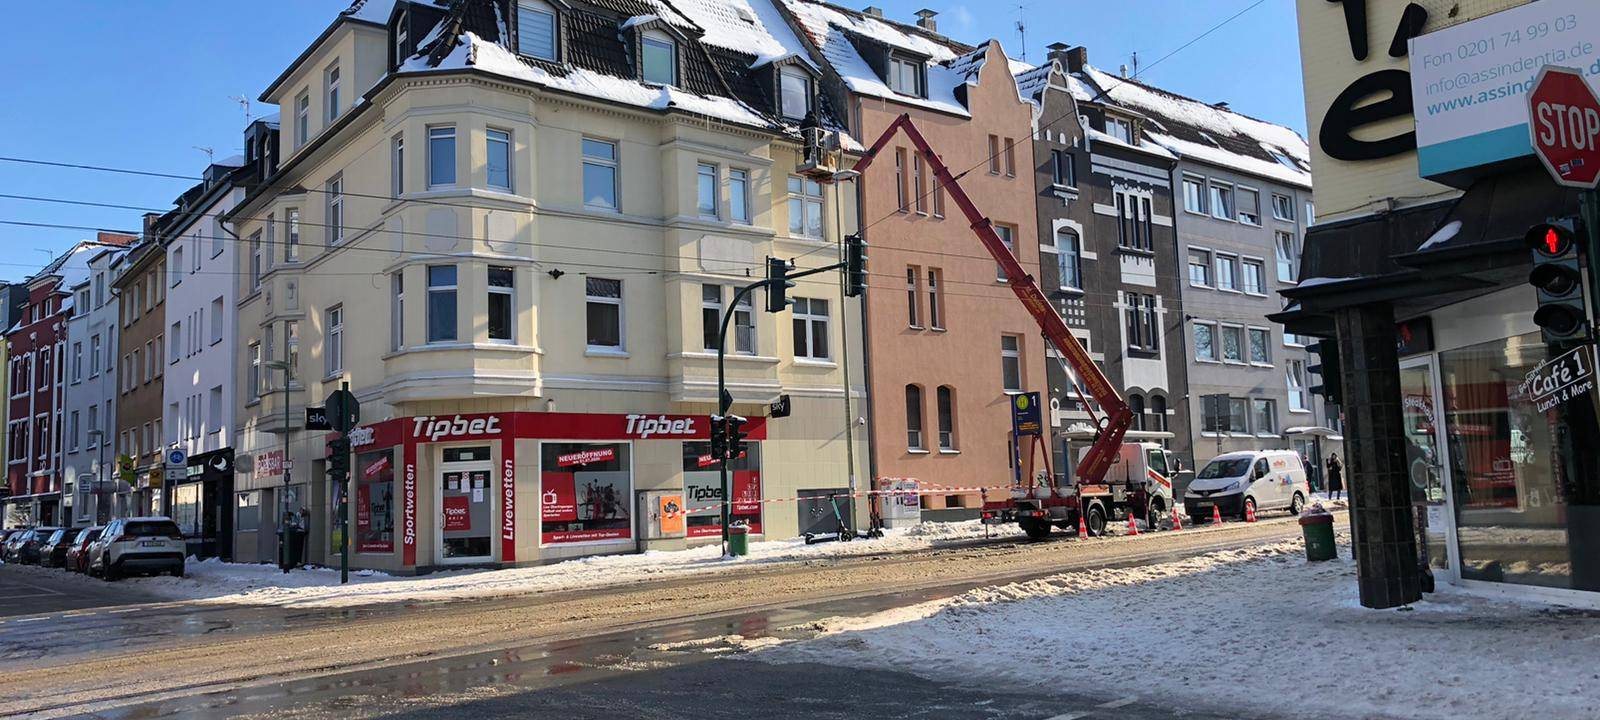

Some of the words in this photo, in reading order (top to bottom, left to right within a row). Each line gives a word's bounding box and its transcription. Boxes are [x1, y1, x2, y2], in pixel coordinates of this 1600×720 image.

[1423, 51, 1452, 69] Fon
[1457, 37, 1495, 60] 0201
[1501, 30, 1521, 48] 74
[1526, 22, 1549, 40] 99
[1555, 14, 1577, 32] 03
[1425, 41, 1593, 96] info@assindentia.de
[1537, 101, 1600, 152] STOP
[1532, 360, 1572, 396] Café
[1573, 351, 1586, 376] 1
[1031, 395, 1037, 407] 1
[1536, 394, 1561, 413] Lunch
[1562, 389, 1569, 401] &
[1570, 381, 1593, 398] More
[413, 414, 502, 442] Tipbet
[625, 414, 697, 438] Tipbet
[404, 464, 416, 545] Sportwetten
[503, 459, 514, 540] Livewetten
[687, 485, 722, 501] Tipbe
